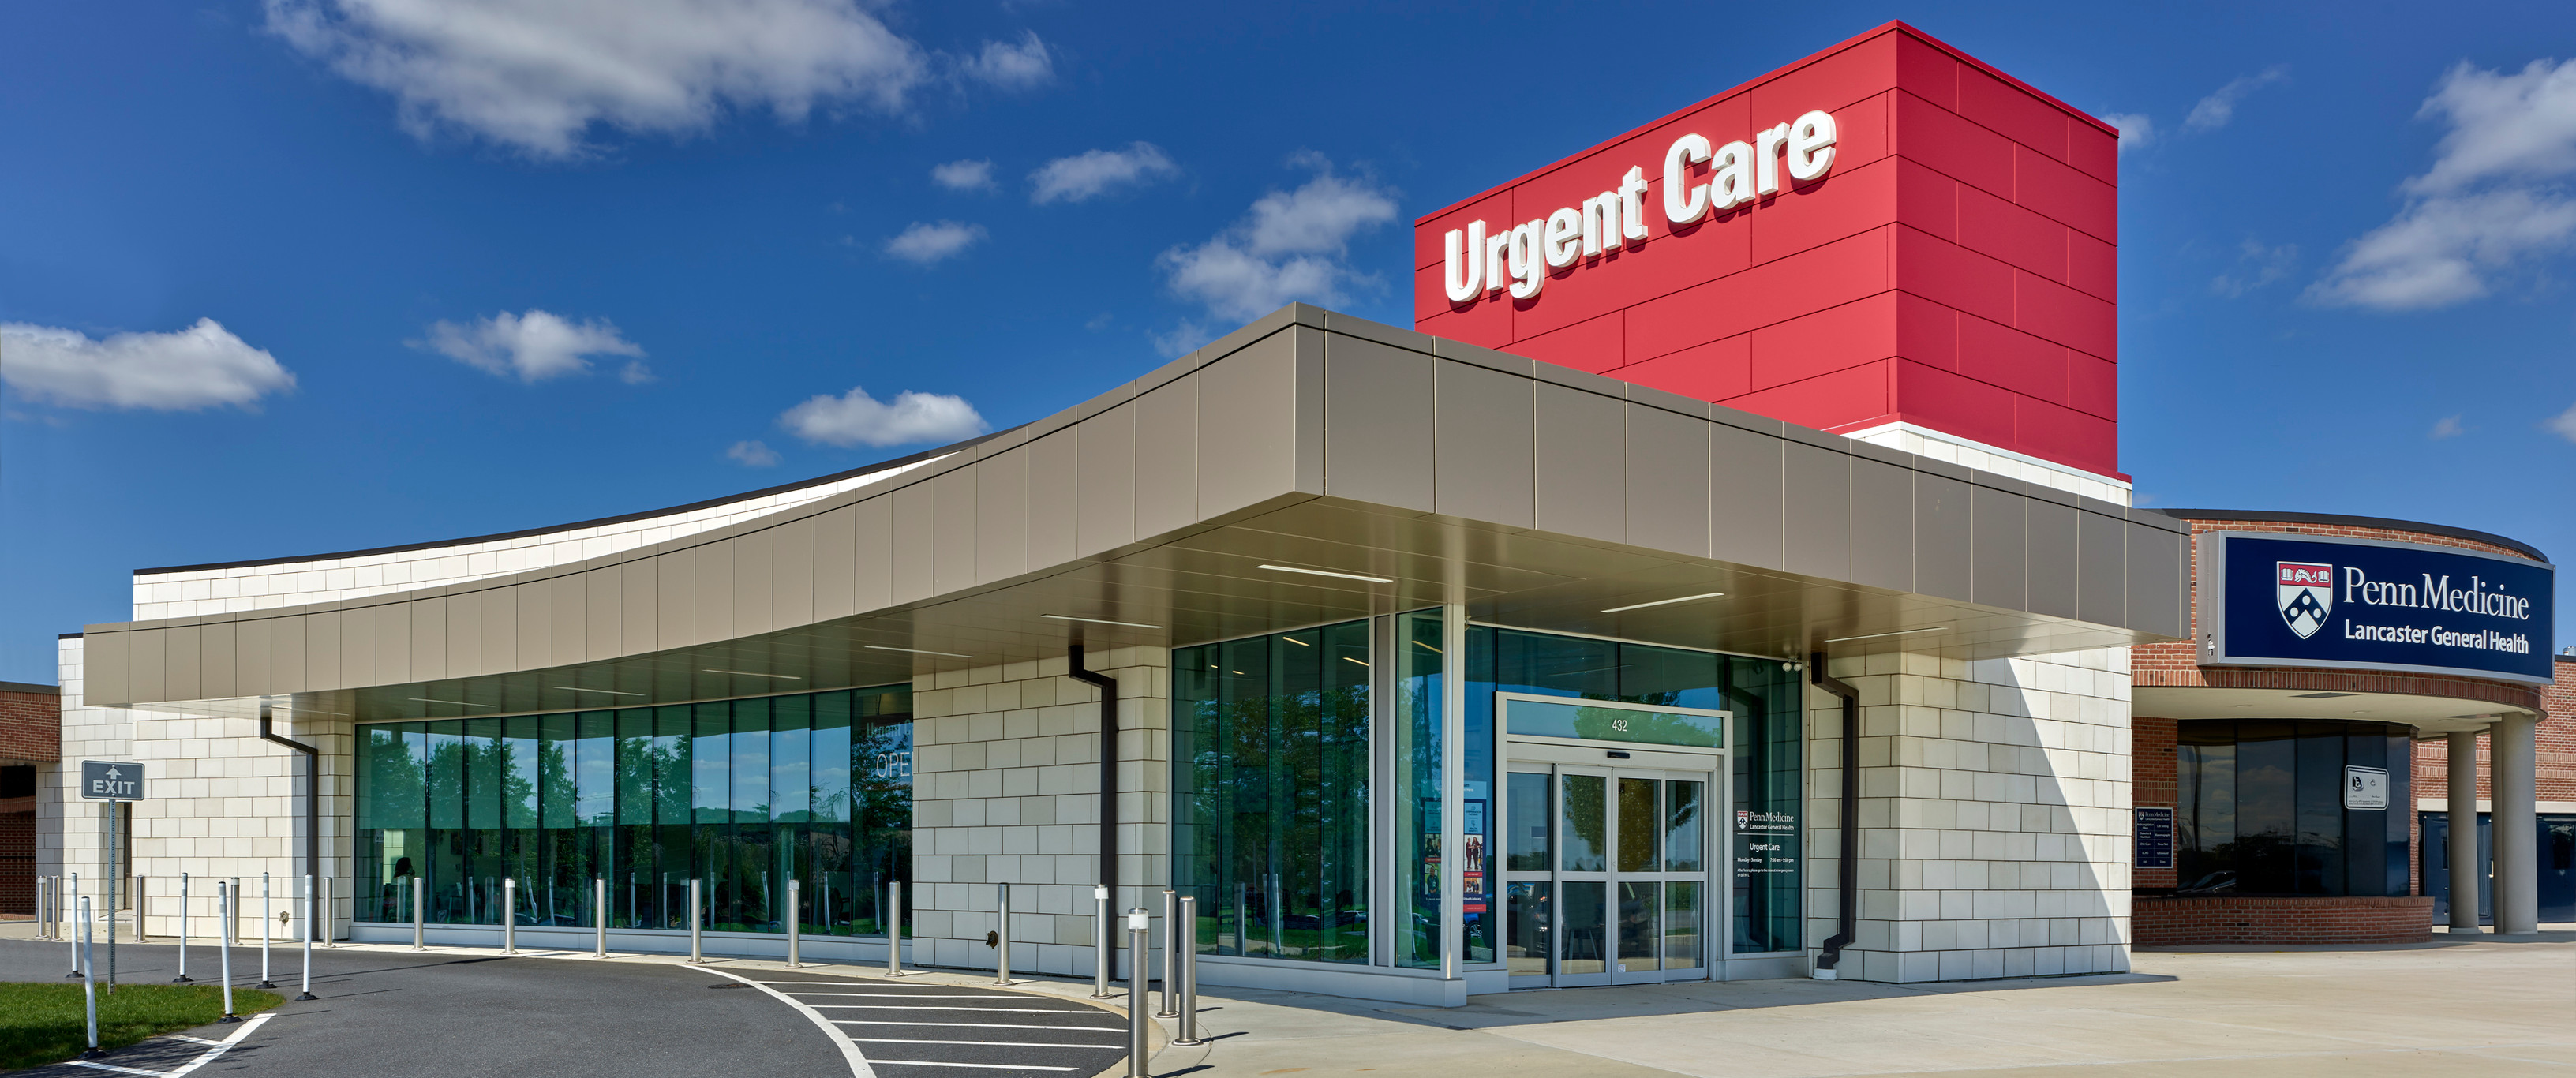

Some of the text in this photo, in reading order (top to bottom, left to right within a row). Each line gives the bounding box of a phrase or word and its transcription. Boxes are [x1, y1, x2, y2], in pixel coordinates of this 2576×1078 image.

[1445, 110, 1836, 302] Urgent Care
[2343, 567, 2529, 620] Penn Medicine
[2345, 619, 2529, 654] Lancaster General Health
[867, 722, 901, 740] Urgent
[1612, 719, 1627, 732] 432
[877, 752, 913, 777] OPE
[92, 780, 135, 795] EXIT
[1750, 811, 1795, 822] Penn Medicine
[1750, 843, 1768, 852] Urgent
